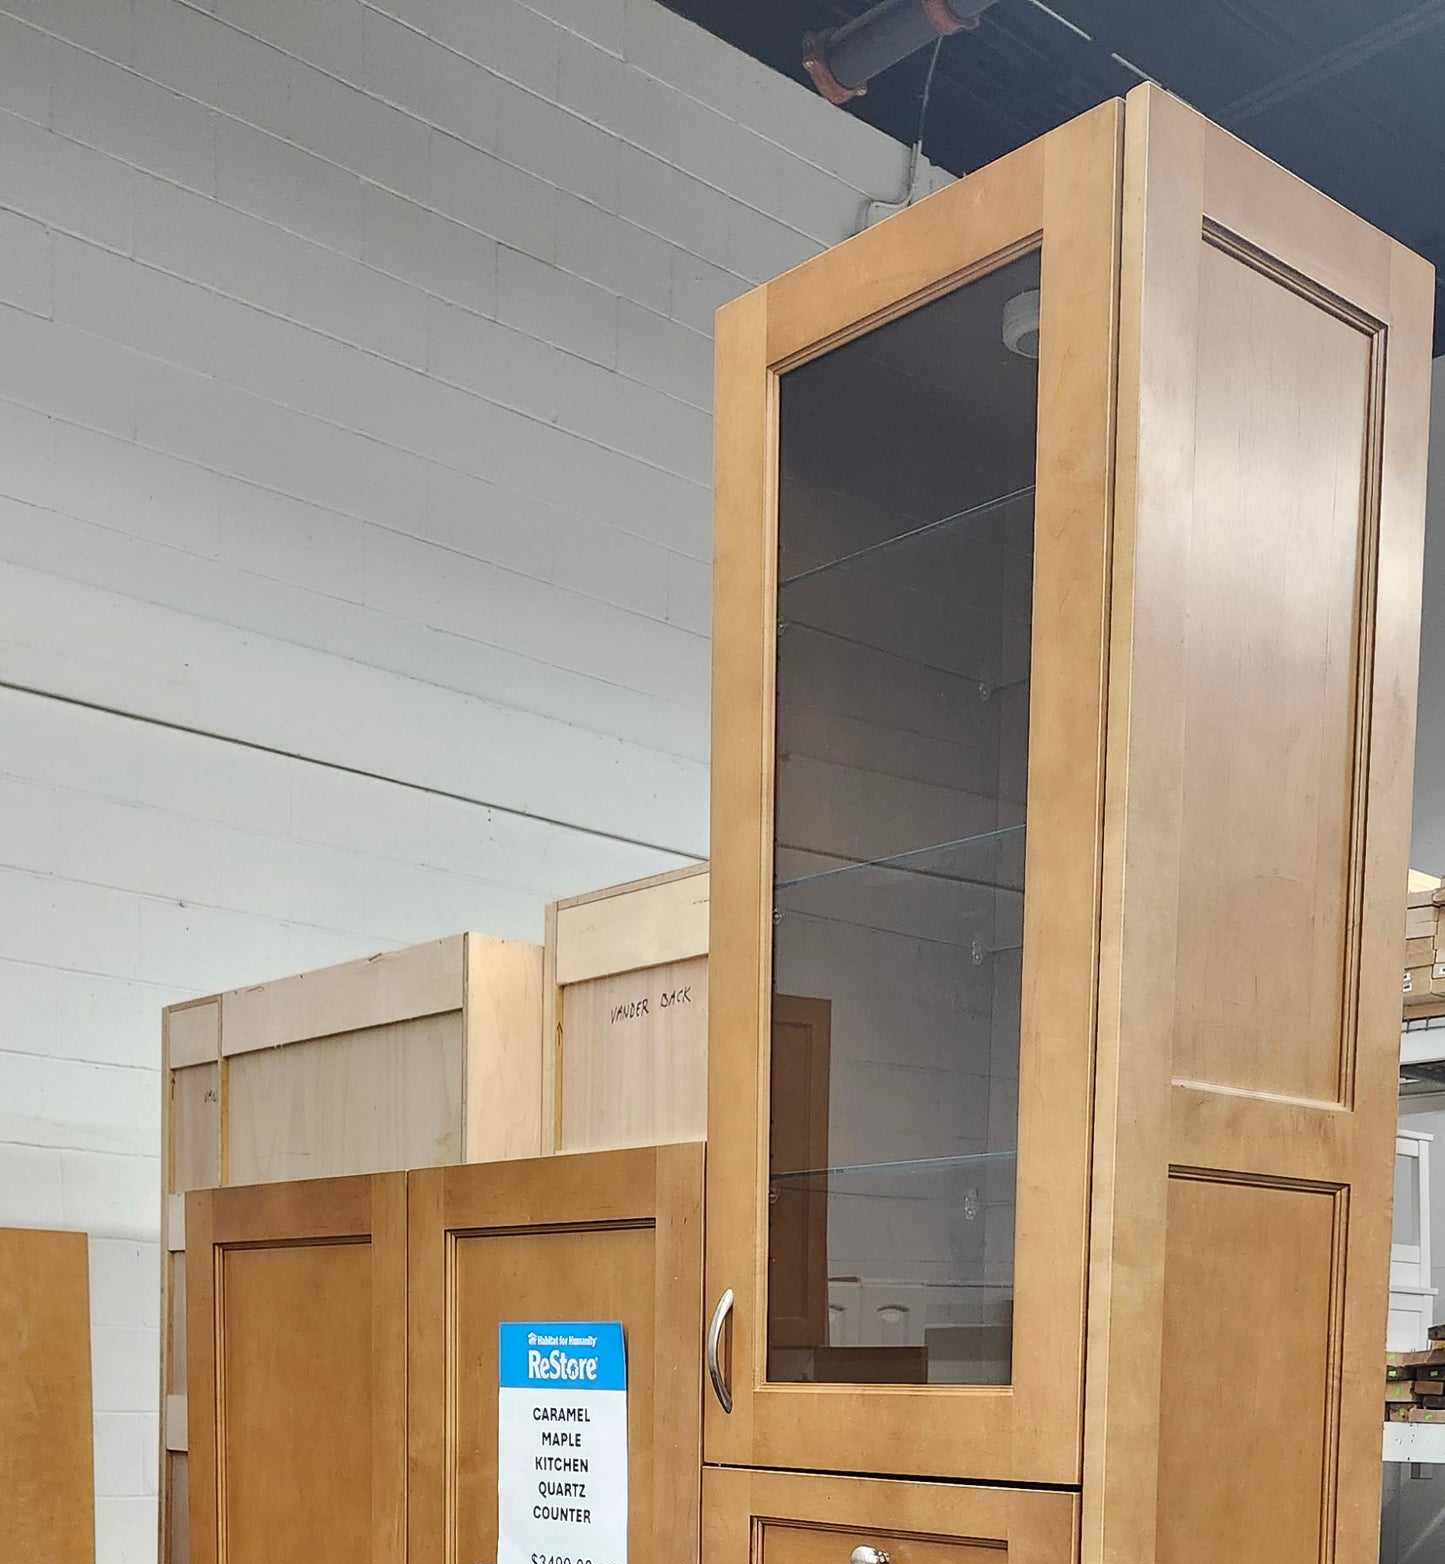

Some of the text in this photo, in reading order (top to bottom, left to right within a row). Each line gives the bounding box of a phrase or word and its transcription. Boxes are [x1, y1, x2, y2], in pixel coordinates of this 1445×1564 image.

[659, 986, 692, 1008] BACK
[537, 1335, 596, 1348] Habitat for Humanity
[528, 1349, 597, 1380] ReStore
[532, 1407, 591, 1423] CARAMEL
[541, 1432, 582, 1448] MAPLE
[534, 1456, 589, 1473] KITCHEN
[538, 1481, 587, 1499] QUARTZ
[533, 1505, 592, 1524] COUNTER
